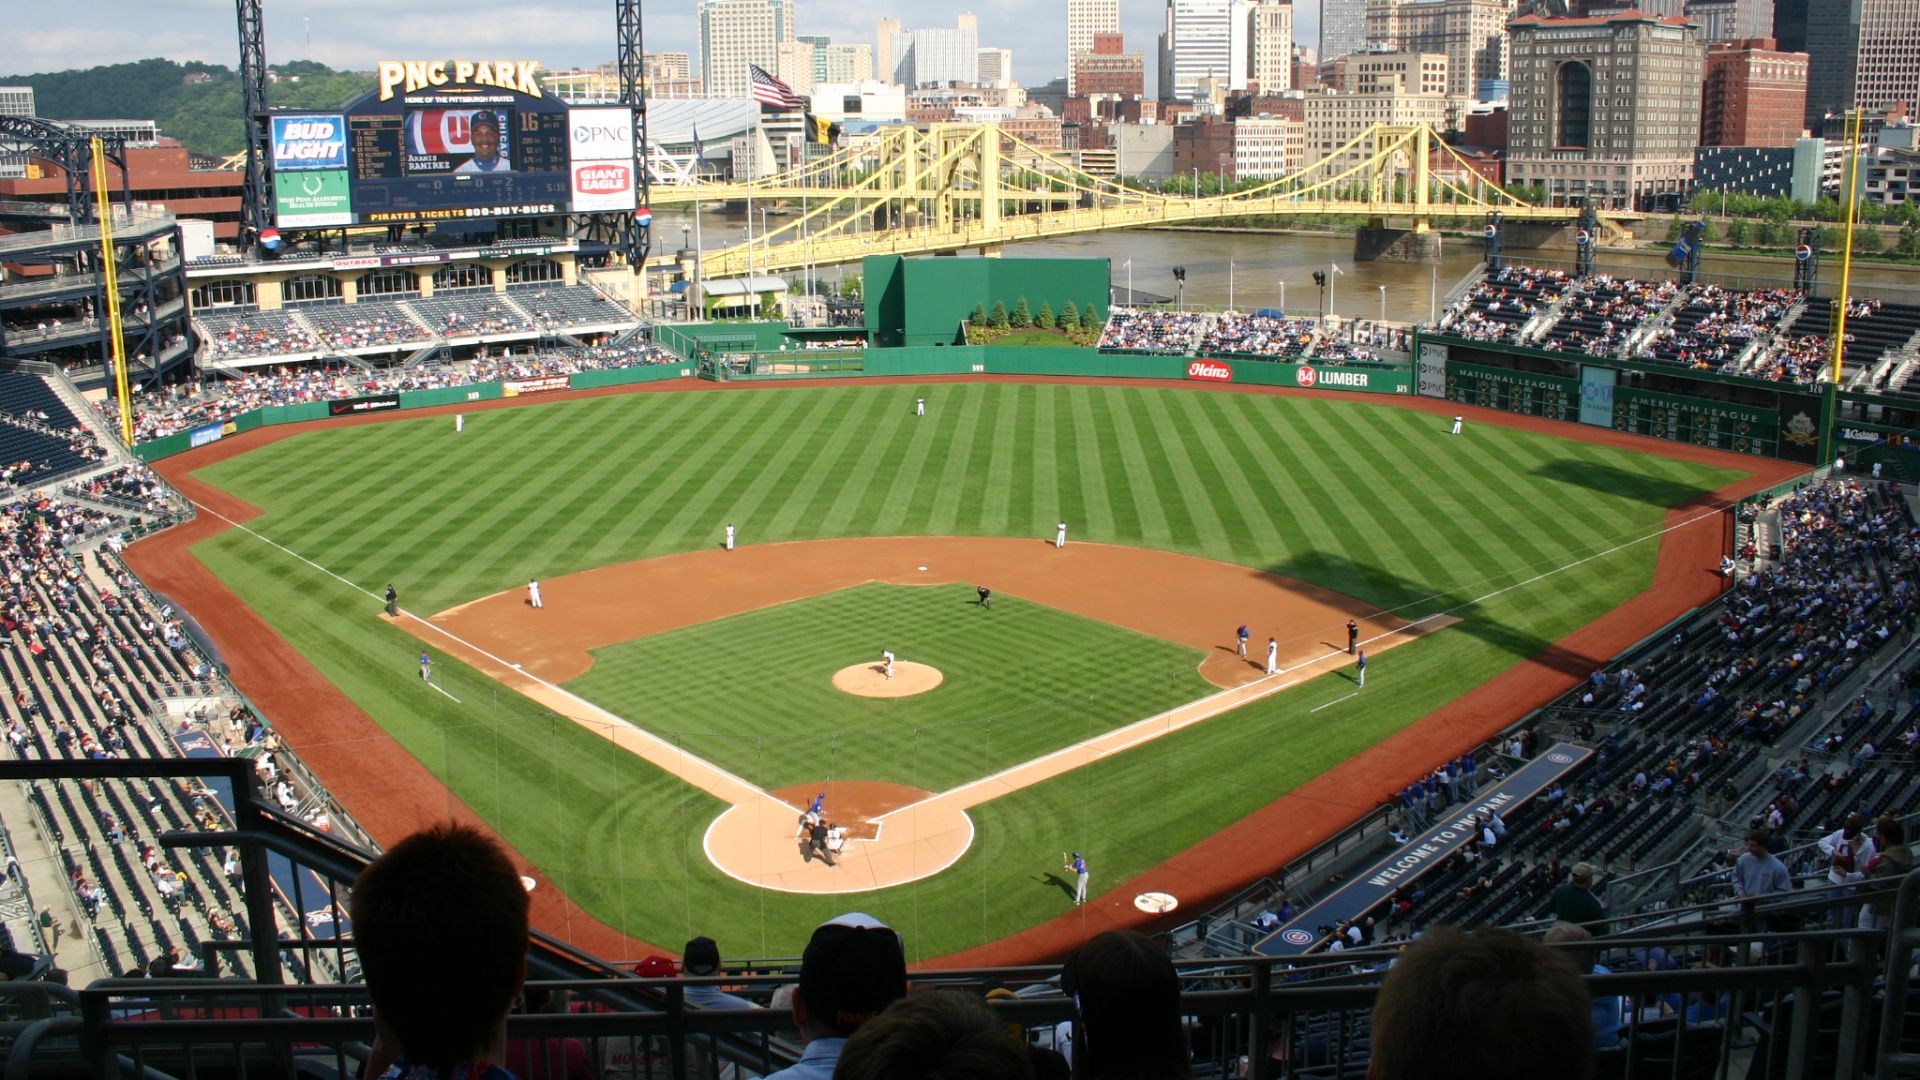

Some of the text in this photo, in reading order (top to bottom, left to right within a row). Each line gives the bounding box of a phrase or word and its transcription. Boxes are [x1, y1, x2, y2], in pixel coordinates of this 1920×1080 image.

[378, 60, 543, 101] PNC PARK
[520, 112, 539, 131] 16
[283, 123, 335, 140] BUD
[591, 126, 629, 142] PNC
[275, 142, 344, 159] LIGHT
[408, 161, 450, 170] RAMIREZ
[580, 169, 625, 180] GIANT
[581, 179, 625, 190] EAGLE
[371, 205, 555, 220] PIRATES TICKETS 800-BUY-BUCS
[335, 259, 380, 267] OUTBACK
[1429, 347, 1446, 358] PNC
[1188, 361, 1229, 378] Heinz
[1428, 364, 1446, 375] PNC
[1298, 369, 1368, 387] 84 LUMBER
[1459, 369, 1514, 384] NATIONAL
[1519, 378, 1563, 392] LEAGUE
[1427, 383, 1446, 393] PNC
[1809, 384, 1823, 394] 320
[1631, 396, 1699, 413] AMERICAN
[1704, 408, 1758, 423] LEAGUE
[1368, 792, 1514, 887] WELCOME TO PNC PARK
